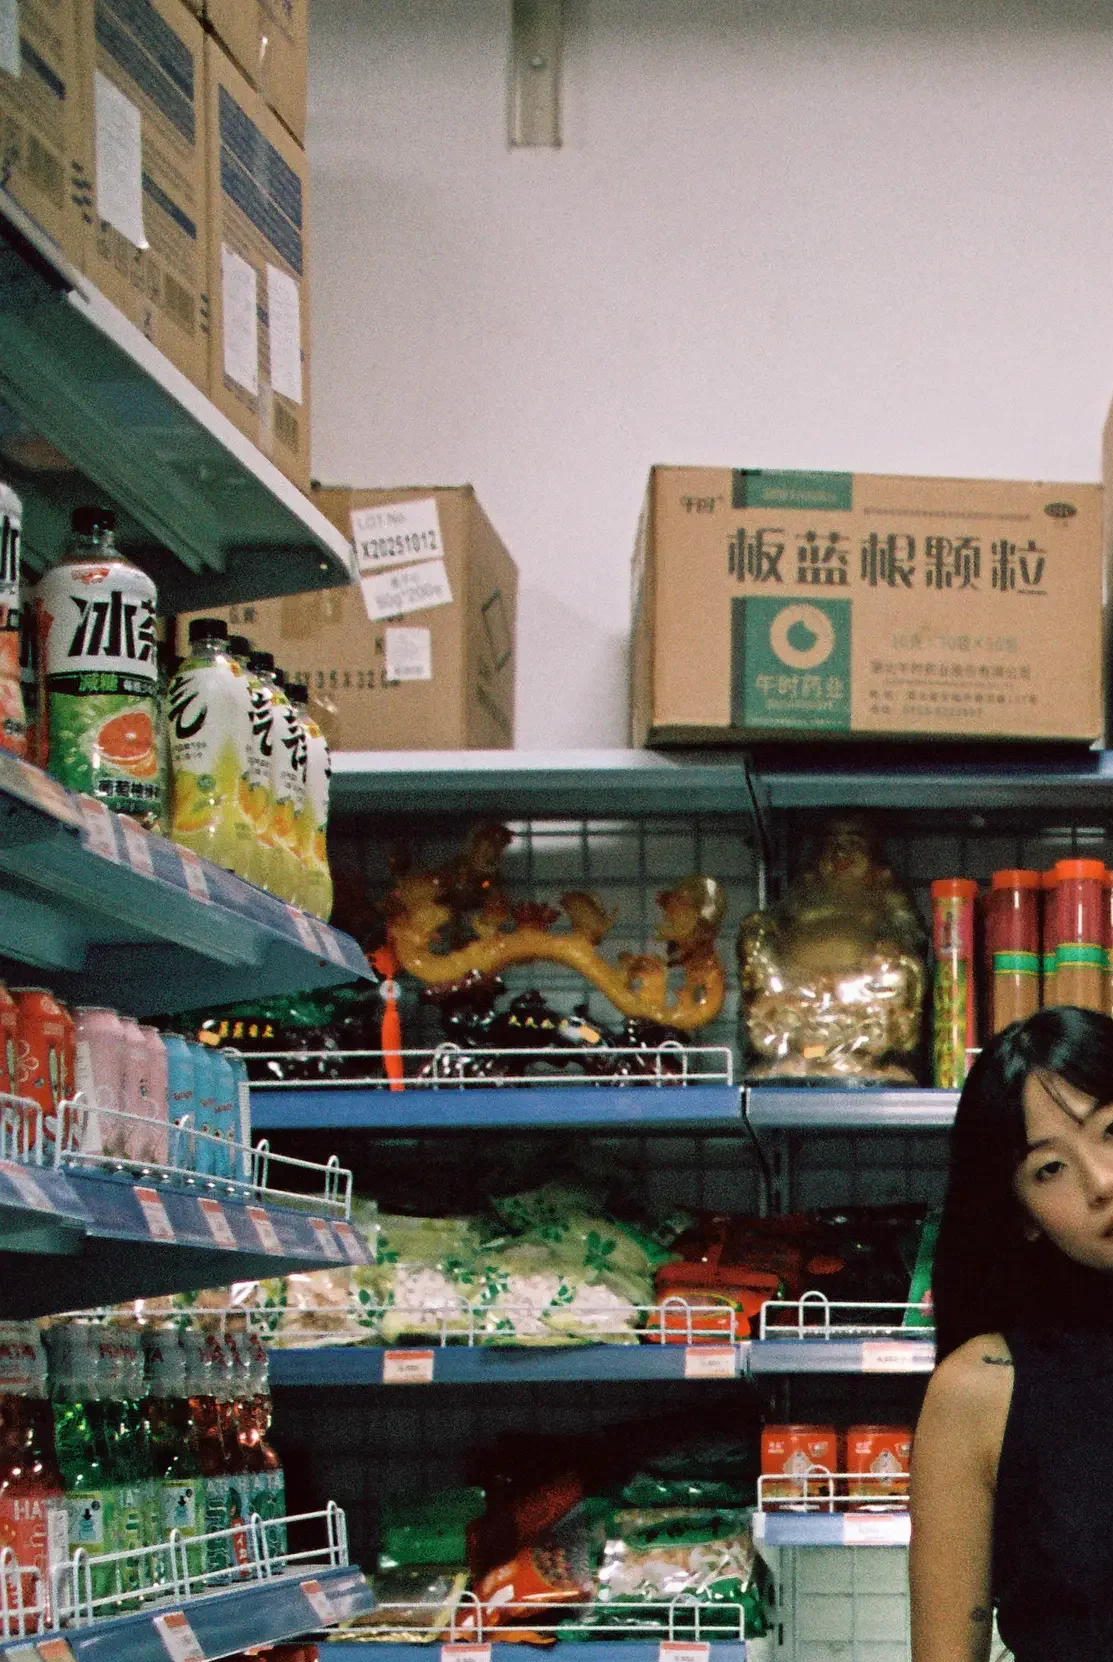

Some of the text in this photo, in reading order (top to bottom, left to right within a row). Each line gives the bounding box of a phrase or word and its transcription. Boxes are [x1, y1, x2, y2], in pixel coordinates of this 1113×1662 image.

[360, 530, 437, 561] X20251012
[726, 527, 1049, 595] 板蓝根颗粒
[755, 673, 844, 699] 午时药业
